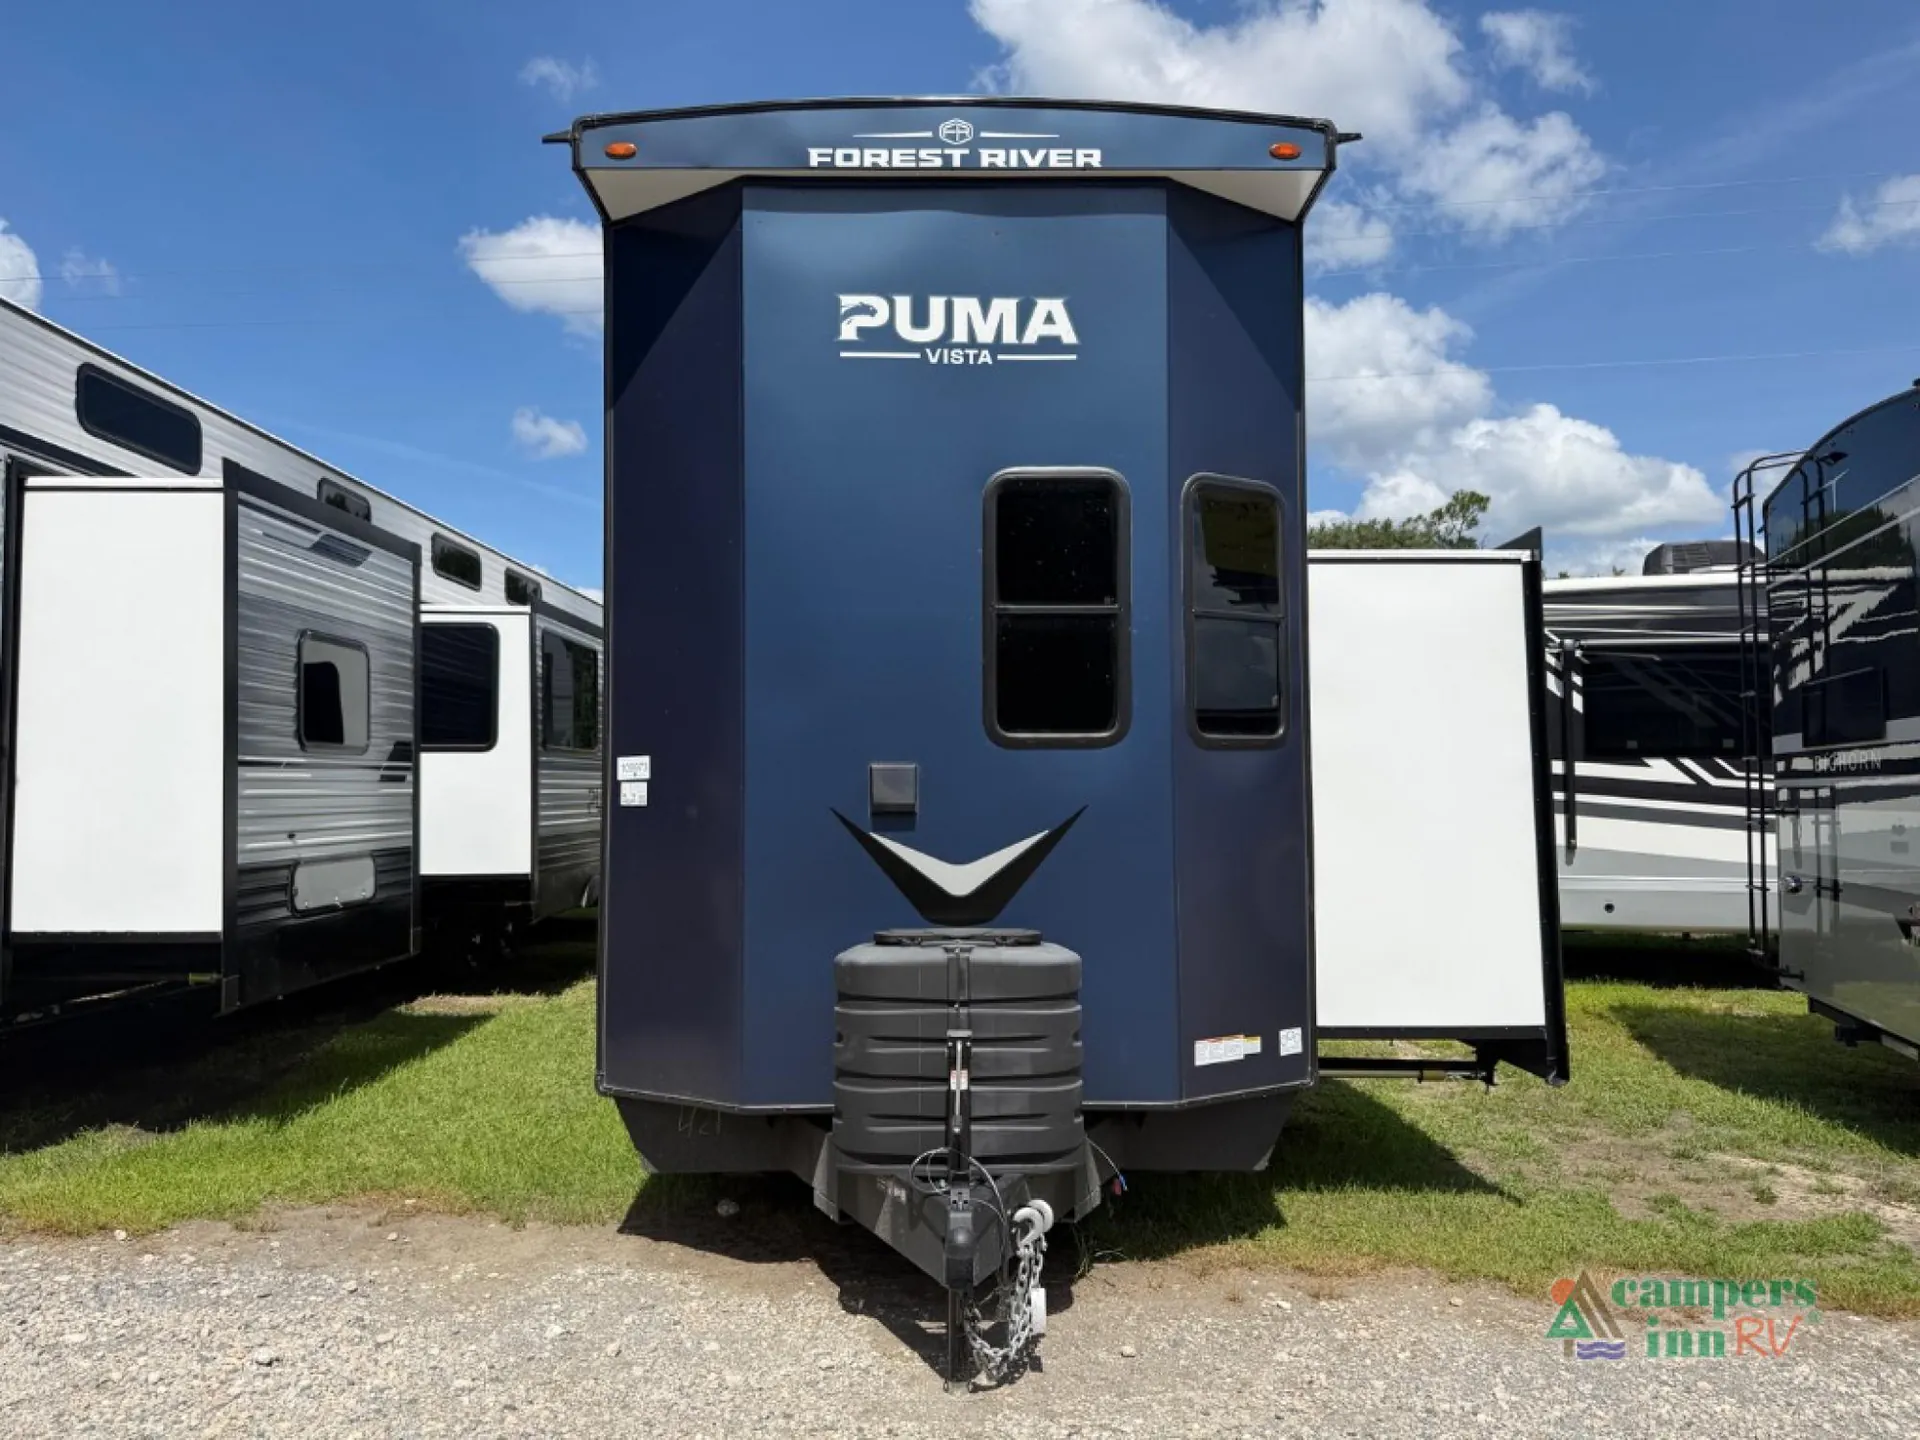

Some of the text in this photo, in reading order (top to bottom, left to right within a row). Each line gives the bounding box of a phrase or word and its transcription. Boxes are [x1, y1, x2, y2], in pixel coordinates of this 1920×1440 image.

[807, 148, 1103, 168] FOREST RIVER
[837, 294, 1080, 345] PUMA
[926, 348, 994, 365] VISTA
